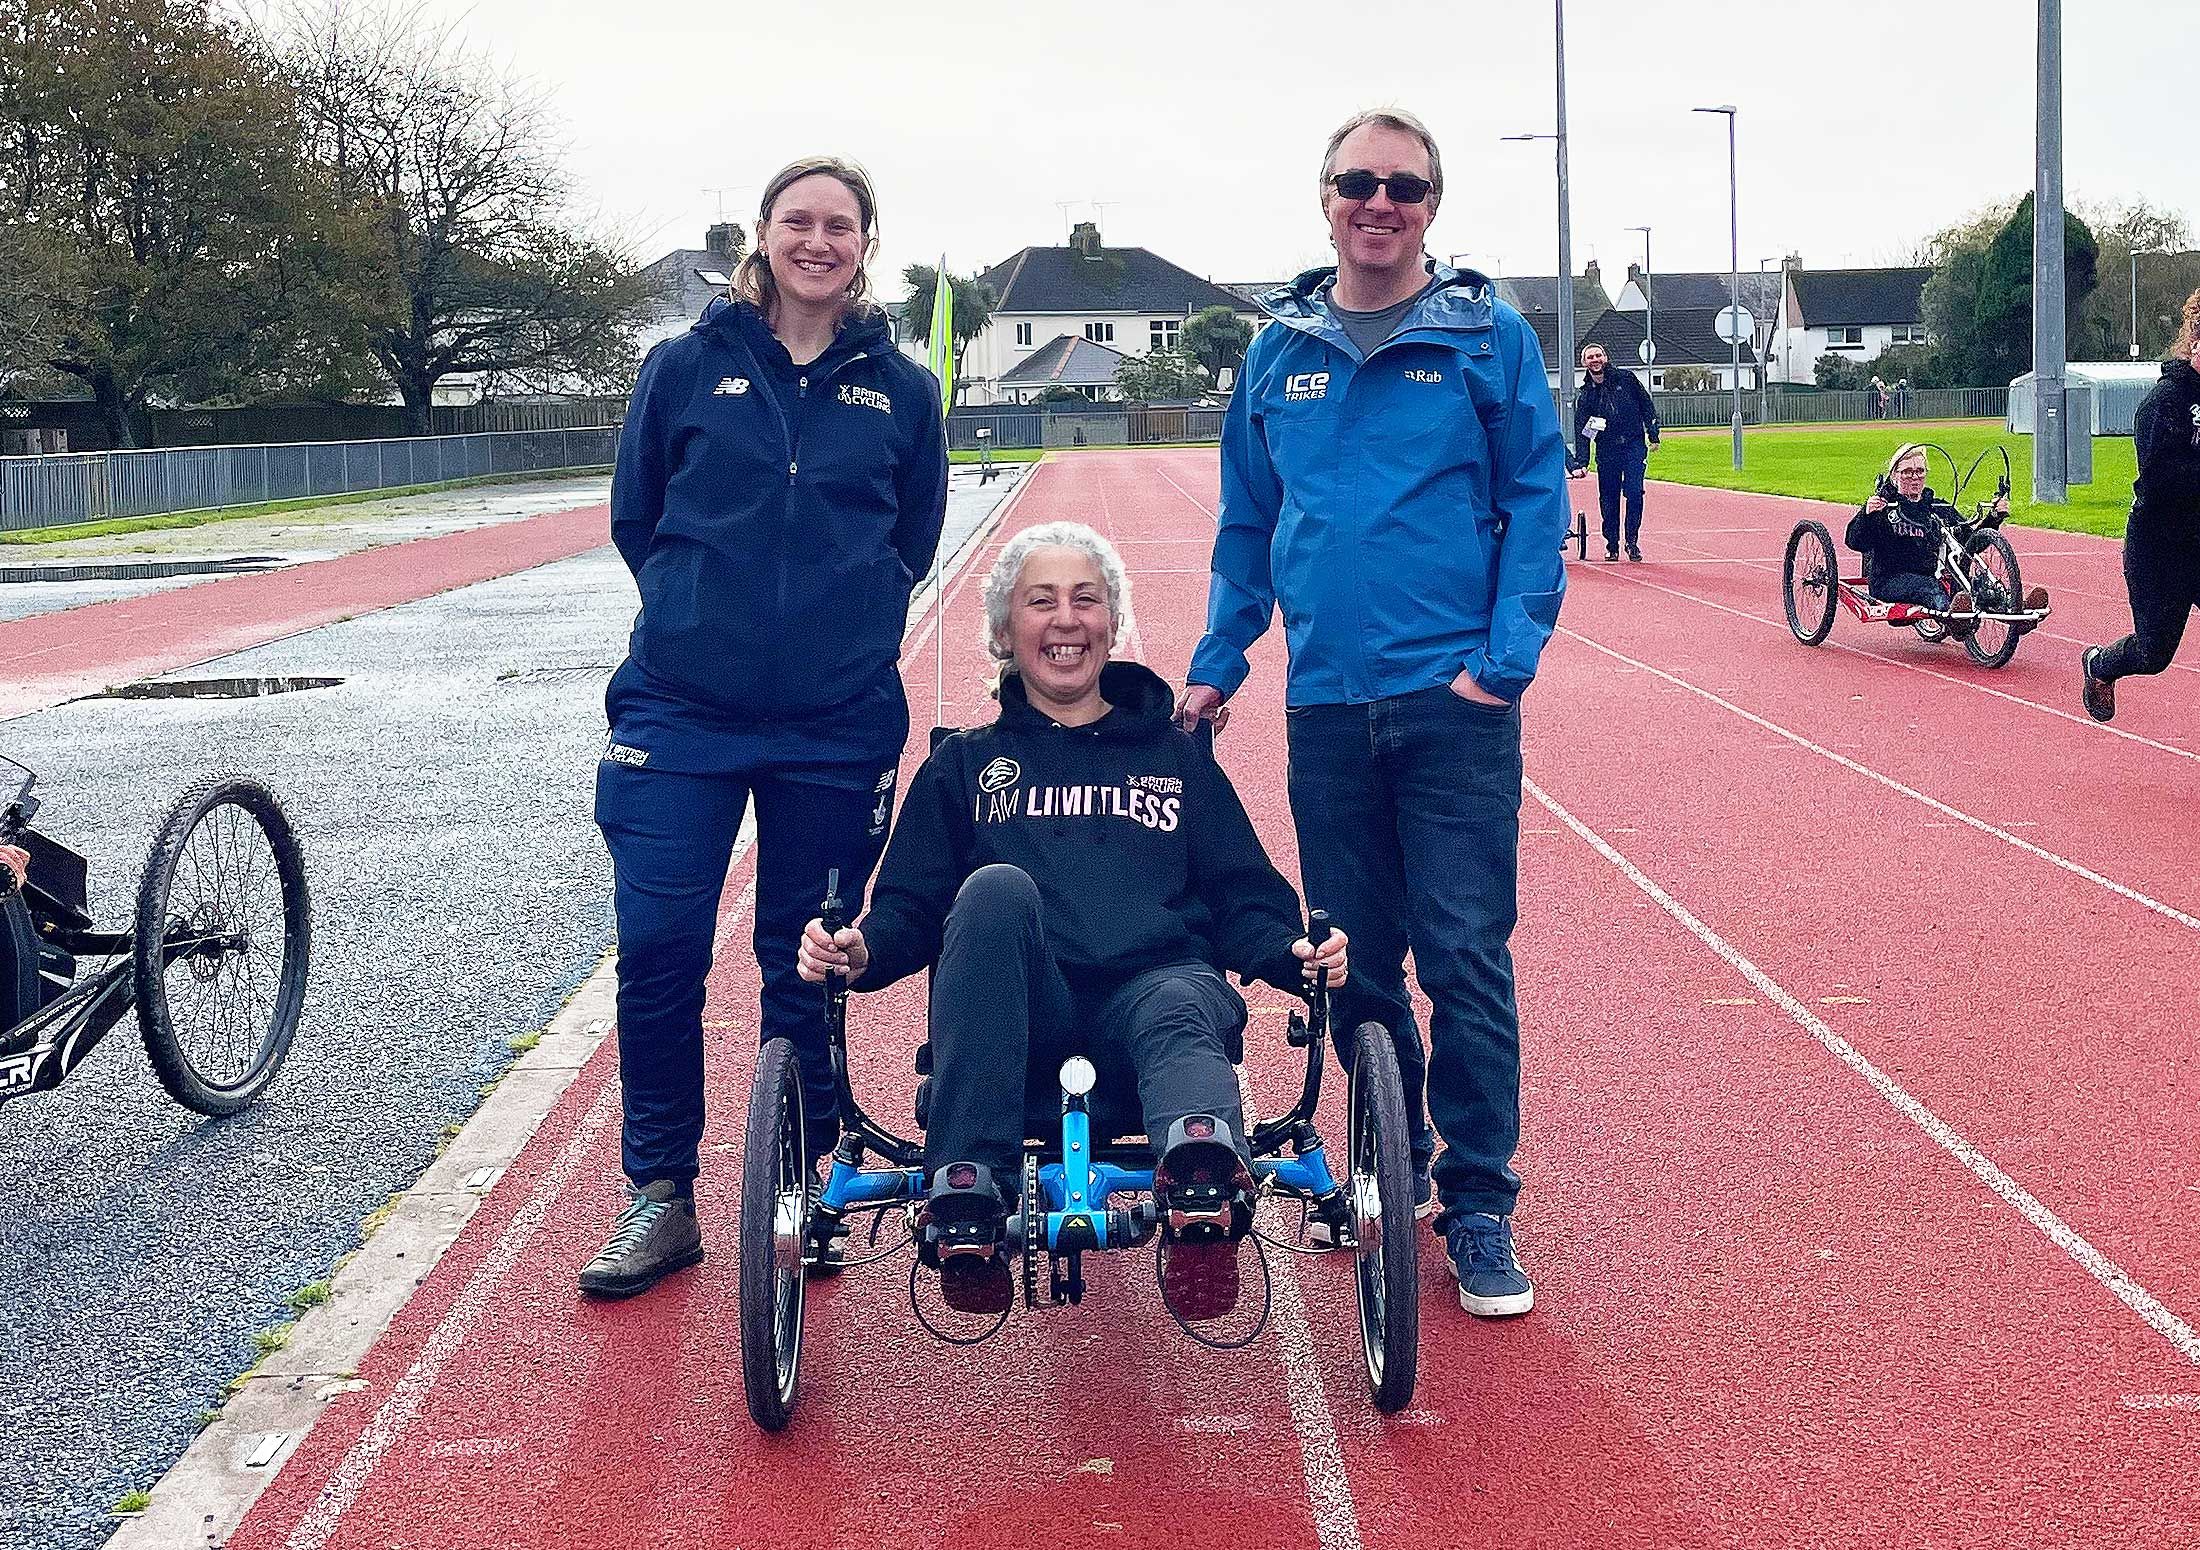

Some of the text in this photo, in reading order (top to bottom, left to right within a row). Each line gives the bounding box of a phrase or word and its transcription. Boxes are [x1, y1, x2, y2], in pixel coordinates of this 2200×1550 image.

[1416, 370, 1442, 383] Rab
[852, 386, 890, 405] BRITISH
[1285, 390, 1326, 401] TRIKES
[852, 395, 891, 414] CYCLING
[1140, 776, 1182, 787] BRITISH
[1140, 782, 1182, 793] CYCLING
[975, 785, 1181, 832] I AM LIMITLESS
